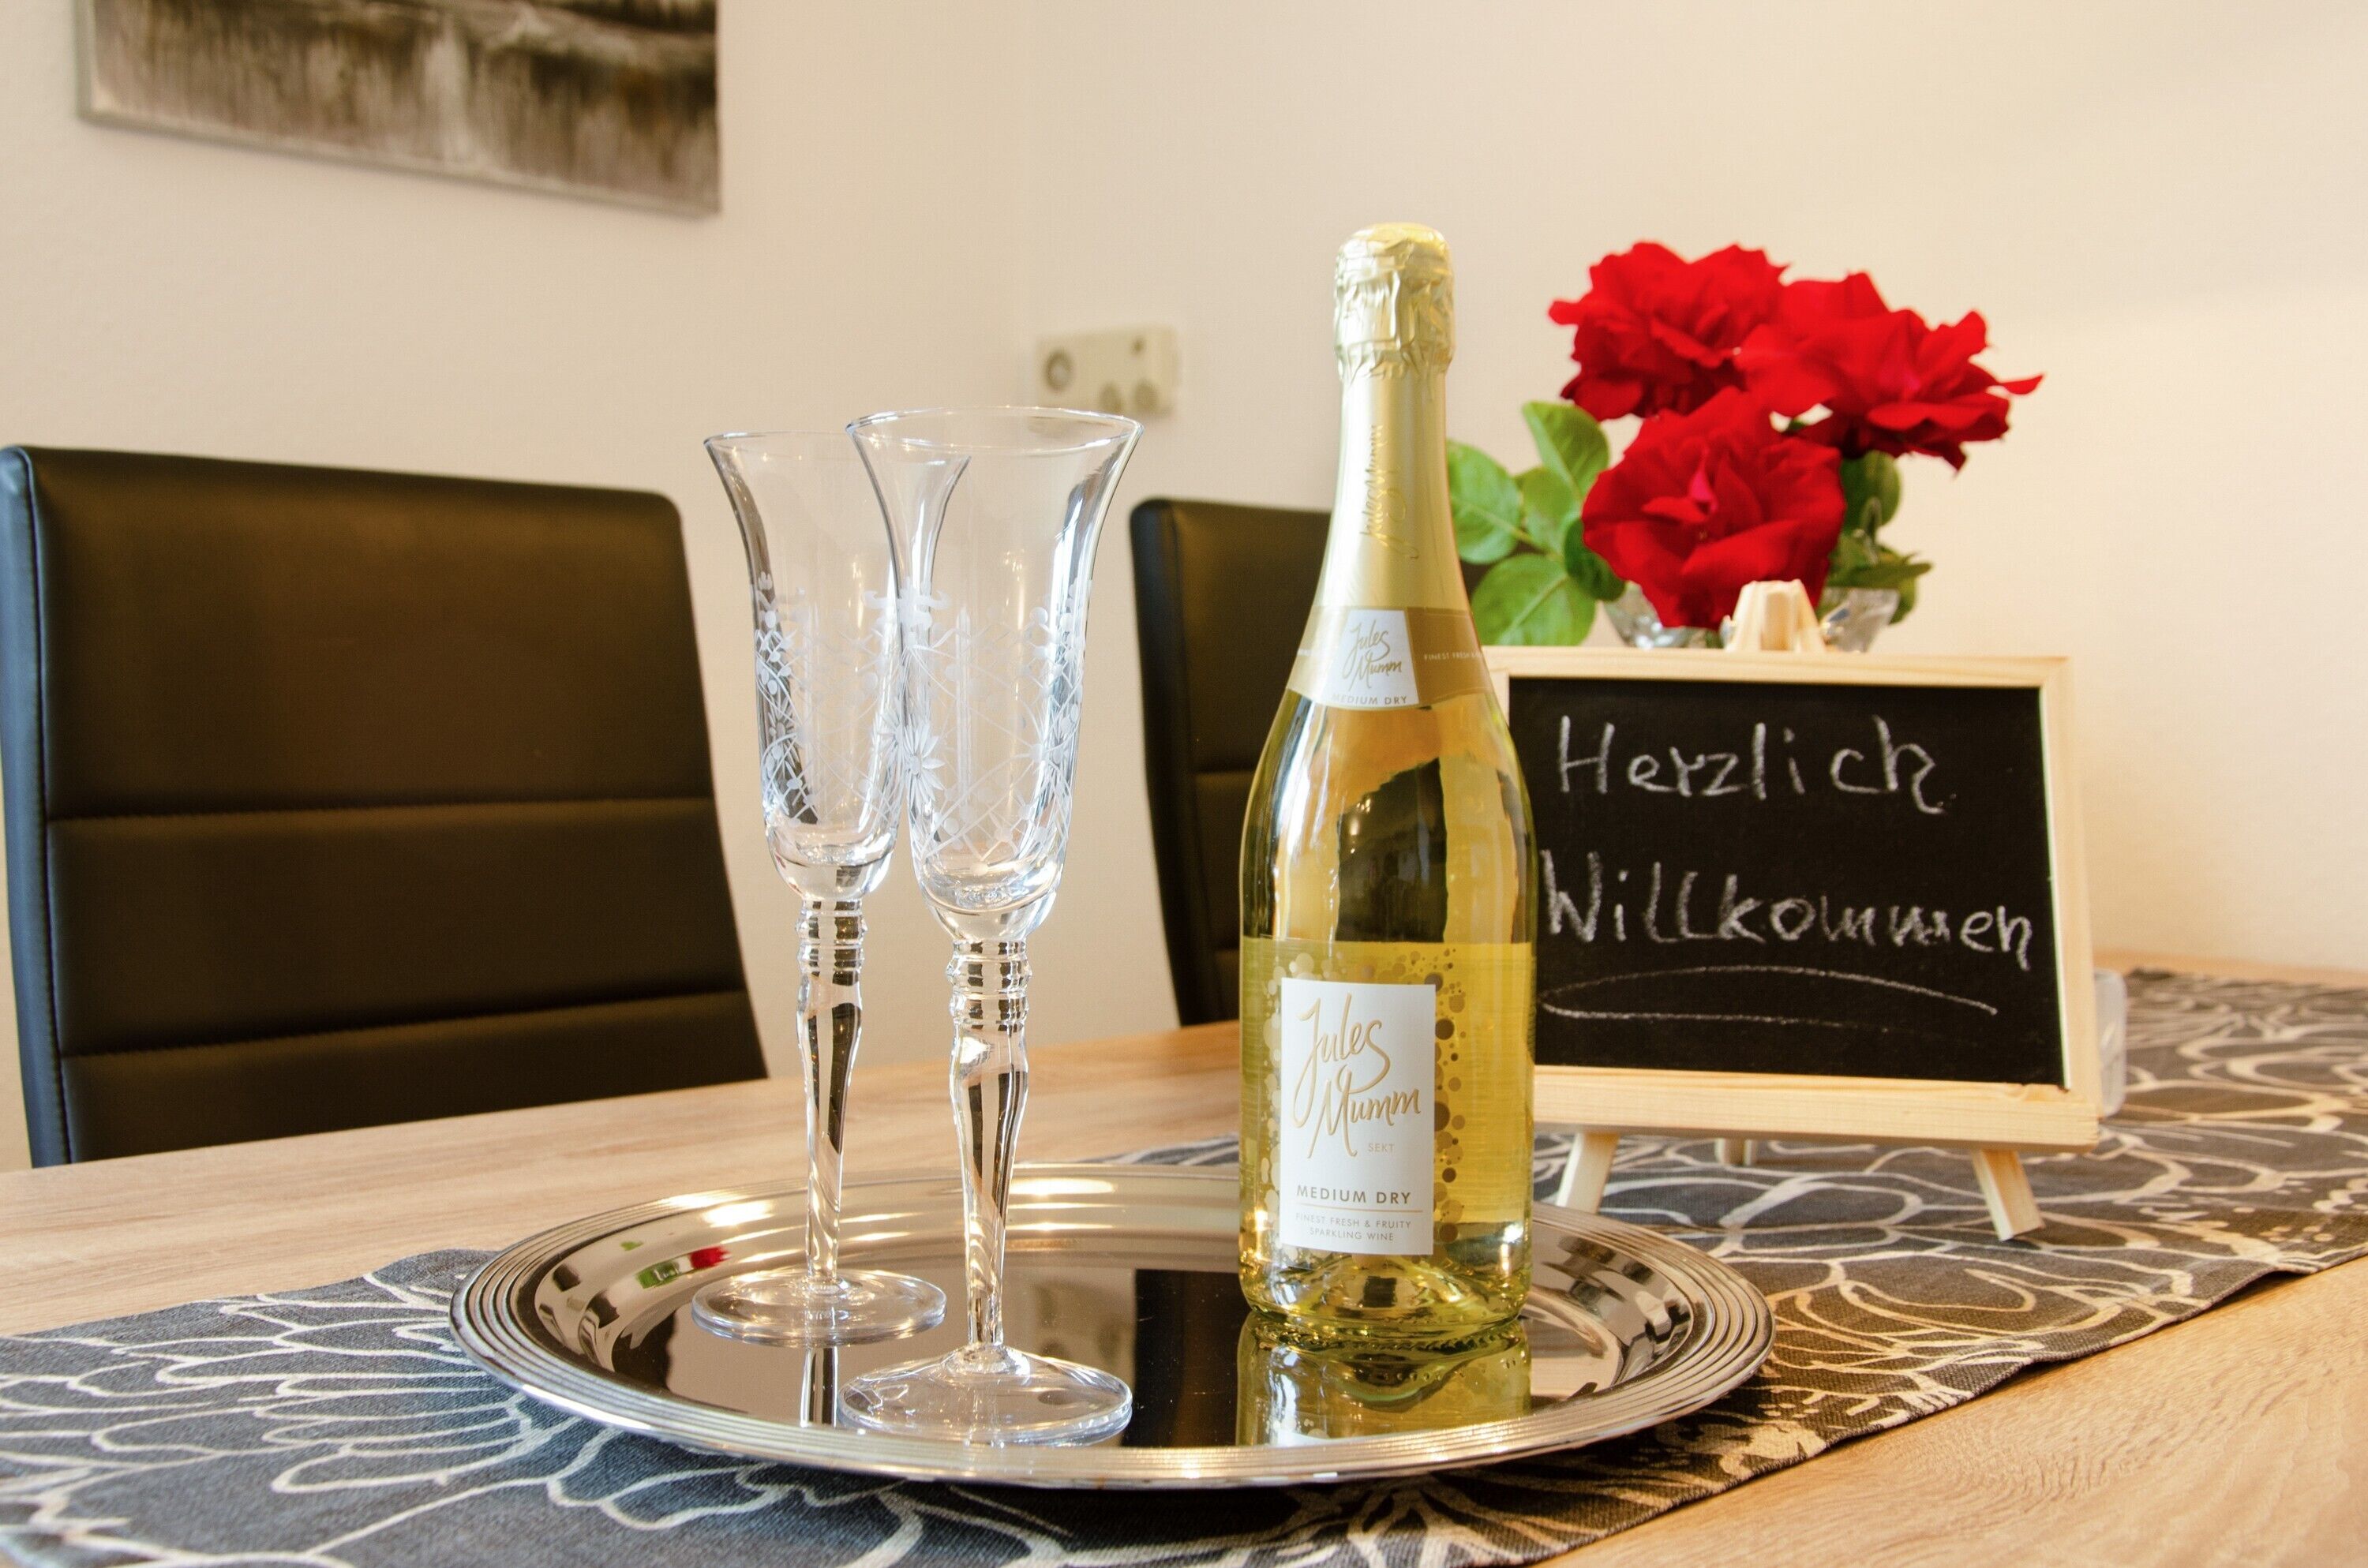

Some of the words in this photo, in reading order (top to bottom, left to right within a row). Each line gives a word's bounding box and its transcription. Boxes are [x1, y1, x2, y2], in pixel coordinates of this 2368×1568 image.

[1343, 619, 1390, 679] Jules
[1347, 652, 1402, 692] Mumm
[1332, 694, 1378, 705] MEDIUM
[1384, 695, 1407, 705] DRY
[1558, 715, 1946, 814] Herzlich
[1540, 848, 2033, 971] Willkommen
[1292, 992, 1391, 1128] Jules
[1306, 1067, 1422, 1158] Mumm
[1368, 1142, 1395, 1154] SEKT
[1296, 1184, 1366, 1203] MEDIUM
[1376, 1191, 1411, 1204] DRY
[1295, 1212, 1325, 1224] FINEST
[1330, 1216, 1360, 1227] FRESH
[1376, 1220, 1411, 1229] FRUITY
[1310, 1227, 1362, 1241] SPARKLING
[1367, 1232, 1395, 1242] WINE
